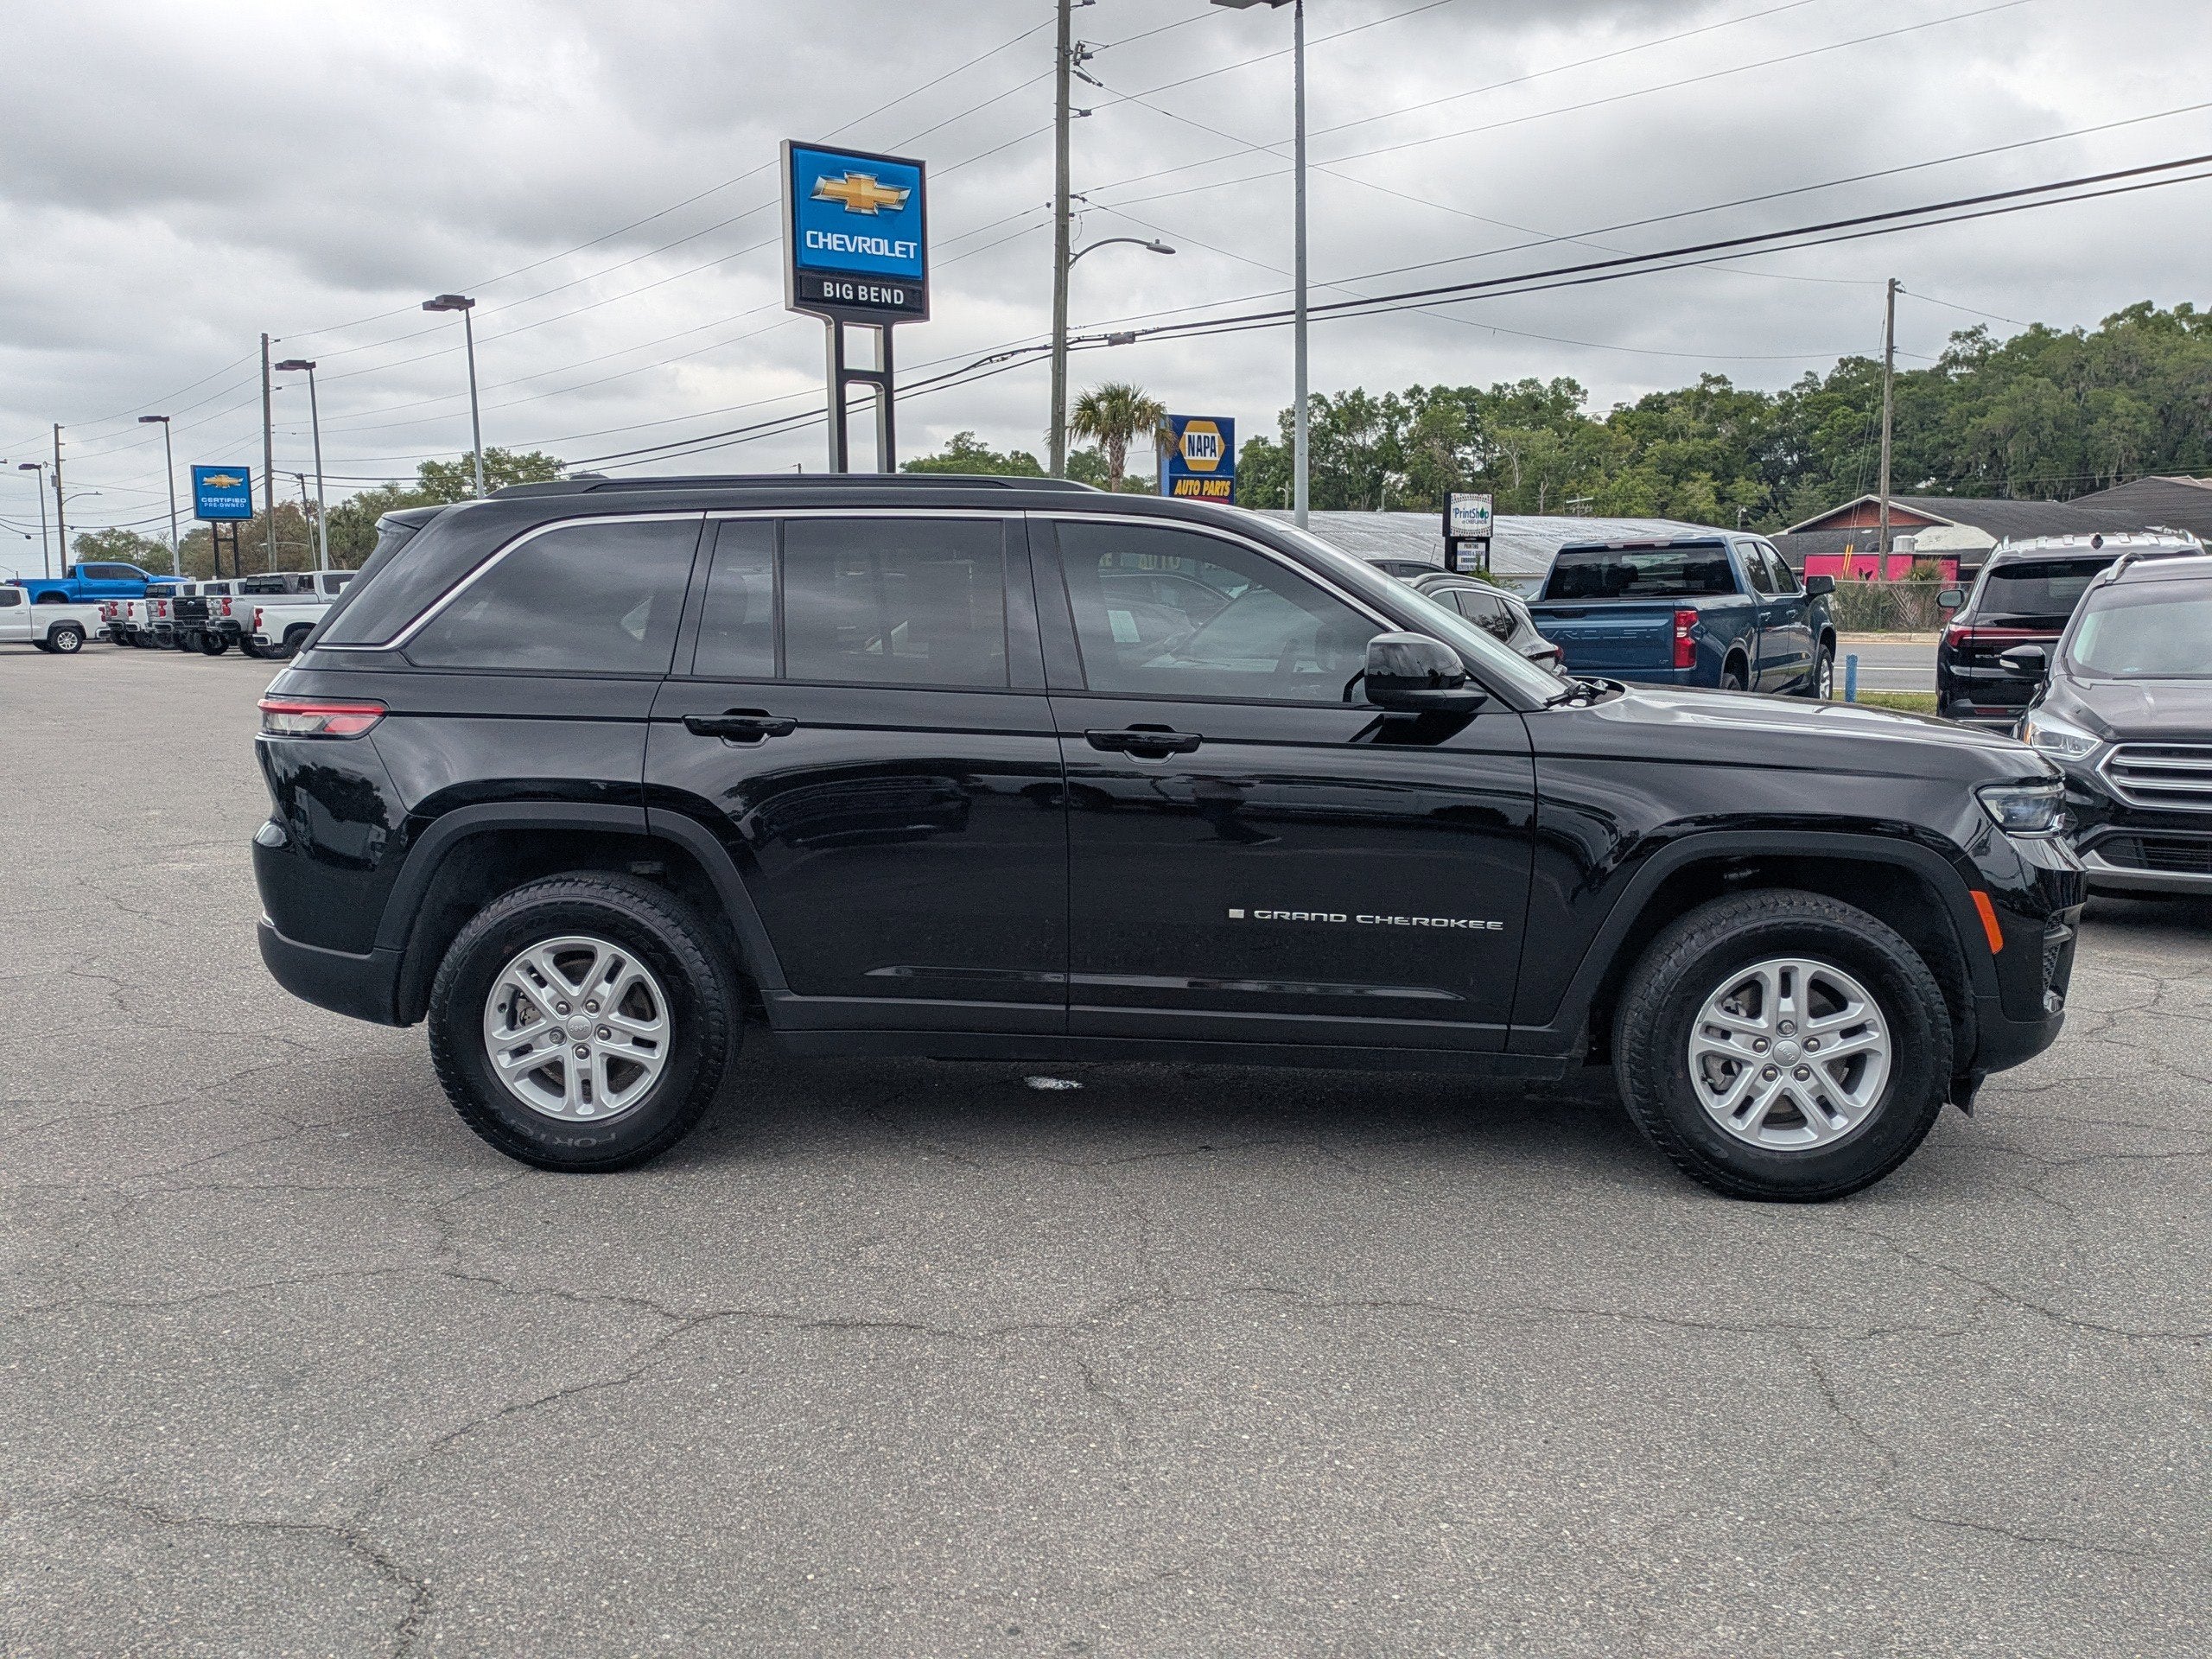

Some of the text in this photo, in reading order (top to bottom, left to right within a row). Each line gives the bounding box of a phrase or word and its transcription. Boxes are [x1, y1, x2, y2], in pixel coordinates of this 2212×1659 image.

[806, 230, 917, 259] CHEVROLET
[823, 282, 904, 304] BIG BEND
[1187, 435, 1217, 457] NAPA
[1174, 480, 1231, 496] AUTO PARTS
[1540, 628, 1658, 640] VROLET
[1254, 910, 1503, 931] GRAND CHEROKEE
